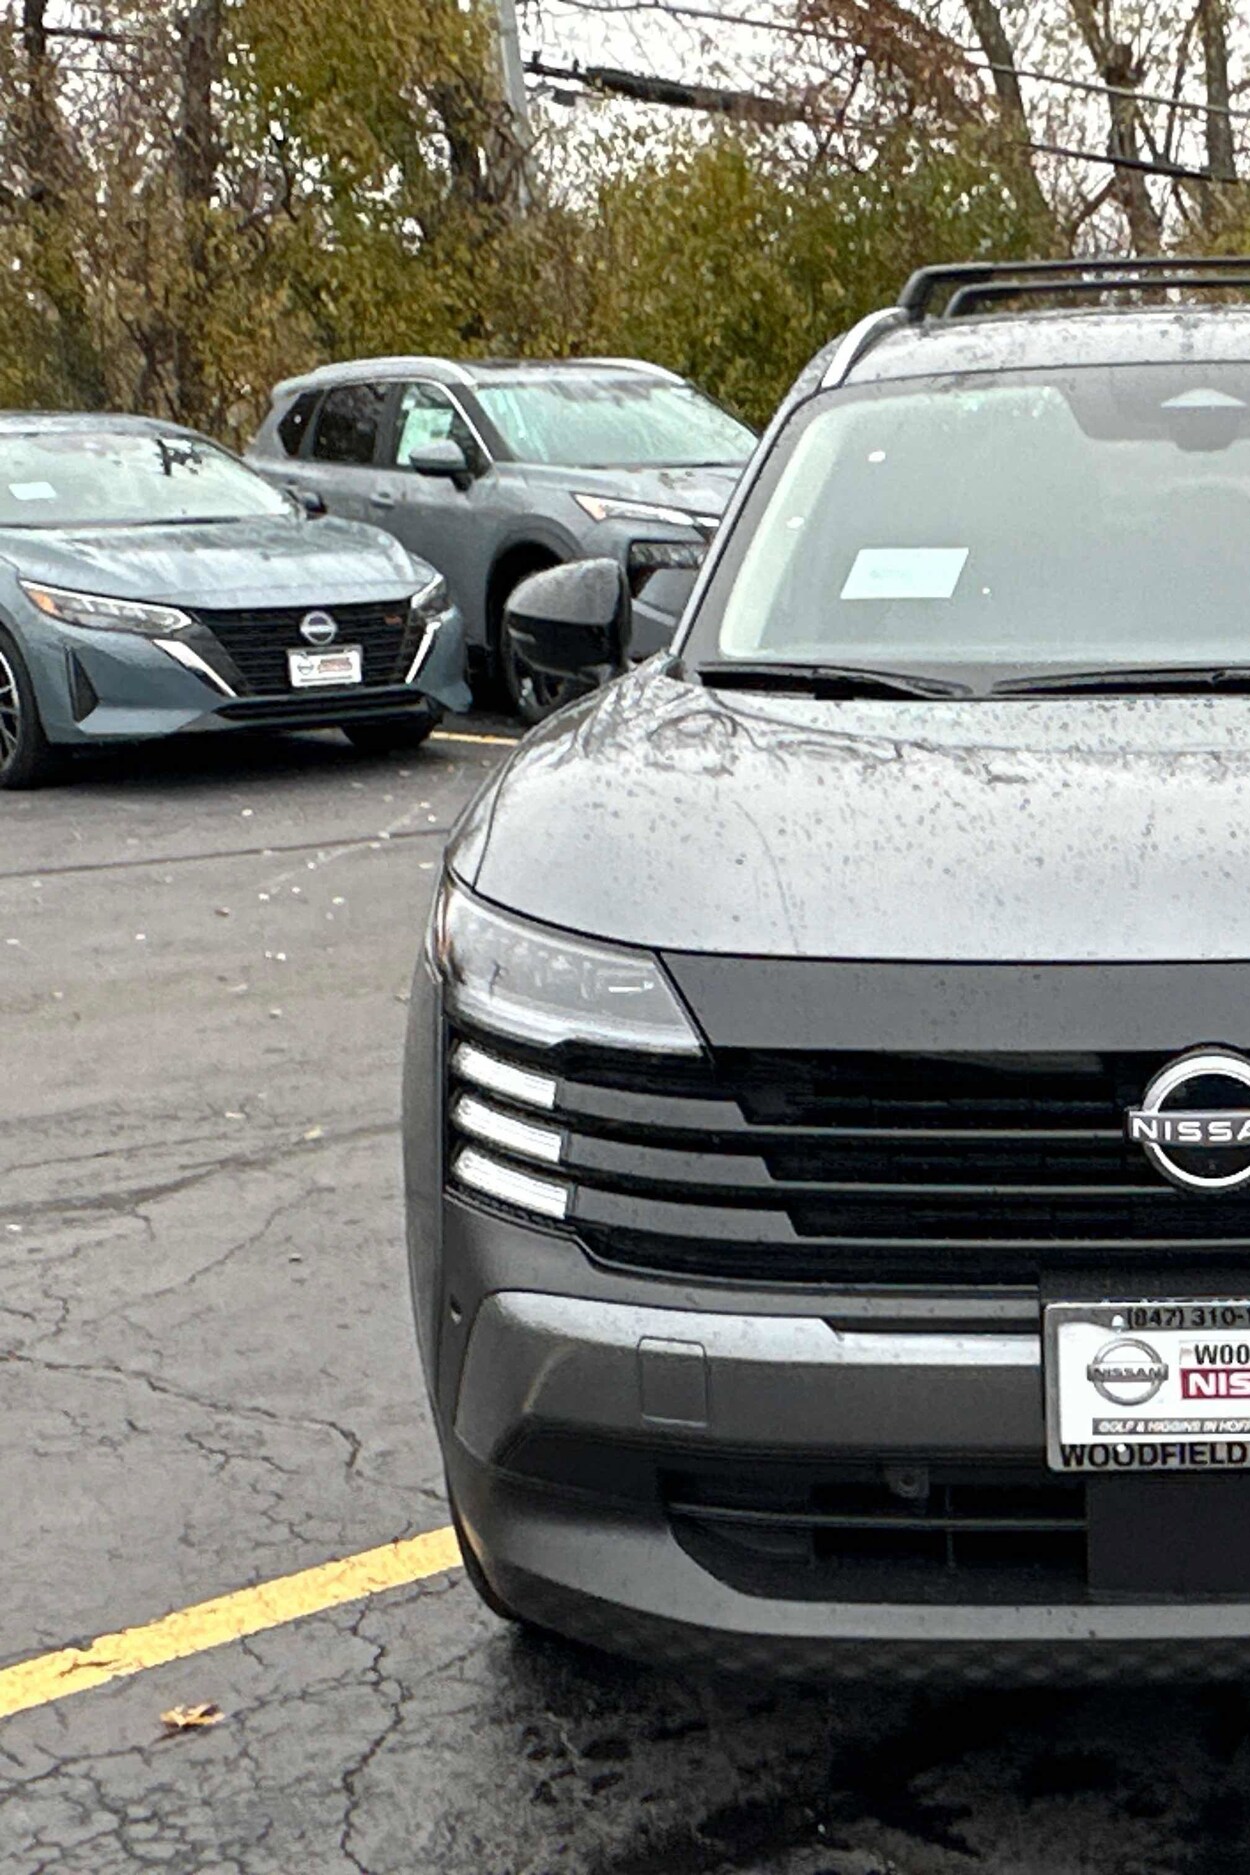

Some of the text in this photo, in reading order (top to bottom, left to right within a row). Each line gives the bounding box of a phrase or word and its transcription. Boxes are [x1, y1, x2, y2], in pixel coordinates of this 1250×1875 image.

[1127, 1307, 1185, 1328] (847)
[1092, 1367, 1163, 1379] NISSAN
[1098, 1420, 1134, 1433] GOLF
[1060, 1442, 1248, 1468] WOODFIELD
